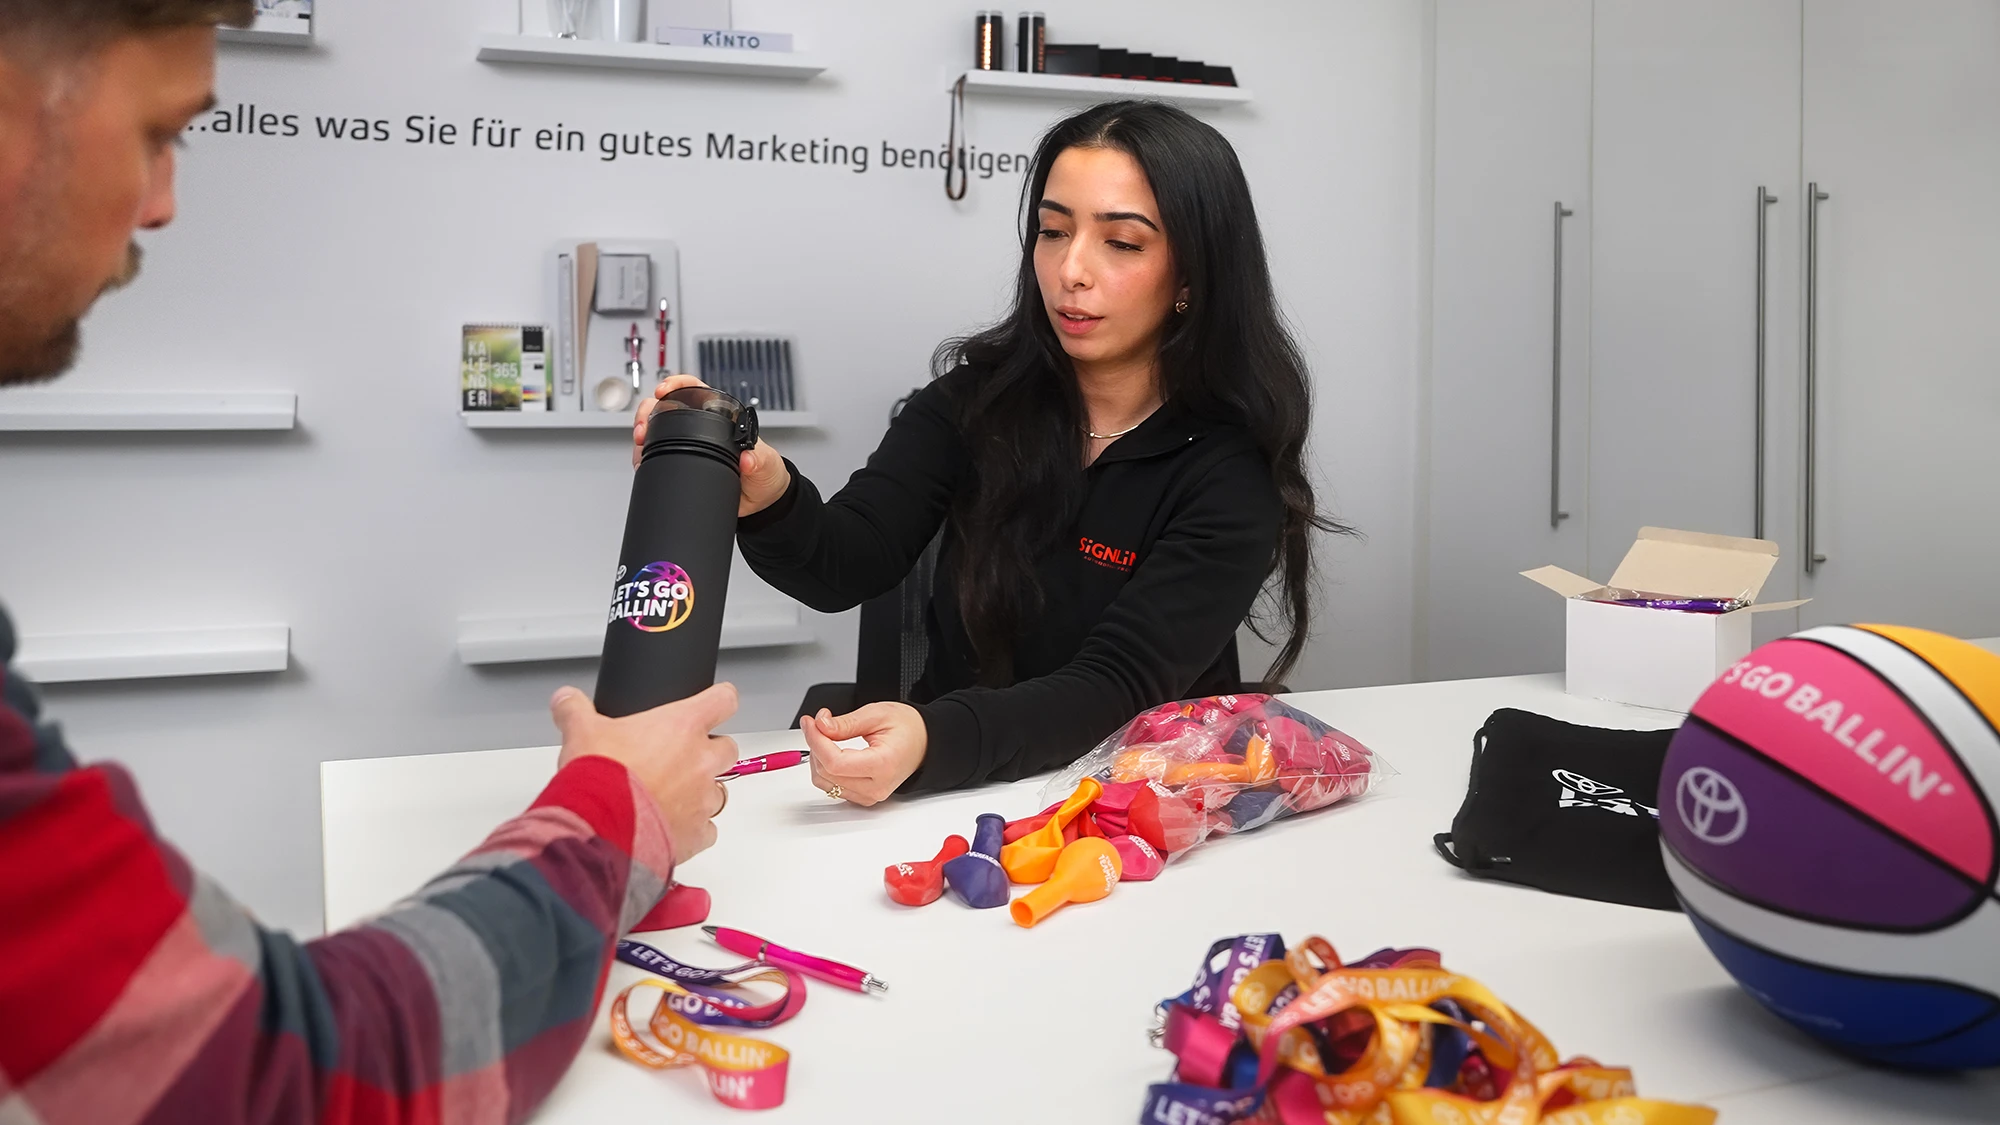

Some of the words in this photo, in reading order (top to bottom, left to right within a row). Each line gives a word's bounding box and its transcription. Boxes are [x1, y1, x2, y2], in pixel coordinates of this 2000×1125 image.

[315, 116, 389, 142] was
[405, 115, 457, 145] Sie
[472, 117, 521, 148] für
[535, 123, 584, 152] ein
[600, 131, 692, 162] gutes
[705, 132, 868, 174] Marketing
[493, 361, 519, 380] 365
[653, 580, 689, 600] GO
[1740, 664, 1795, 699] GO
[1783, 682, 1955, 802] BALLIN'
[630, 945, 680, 973] LET'S
